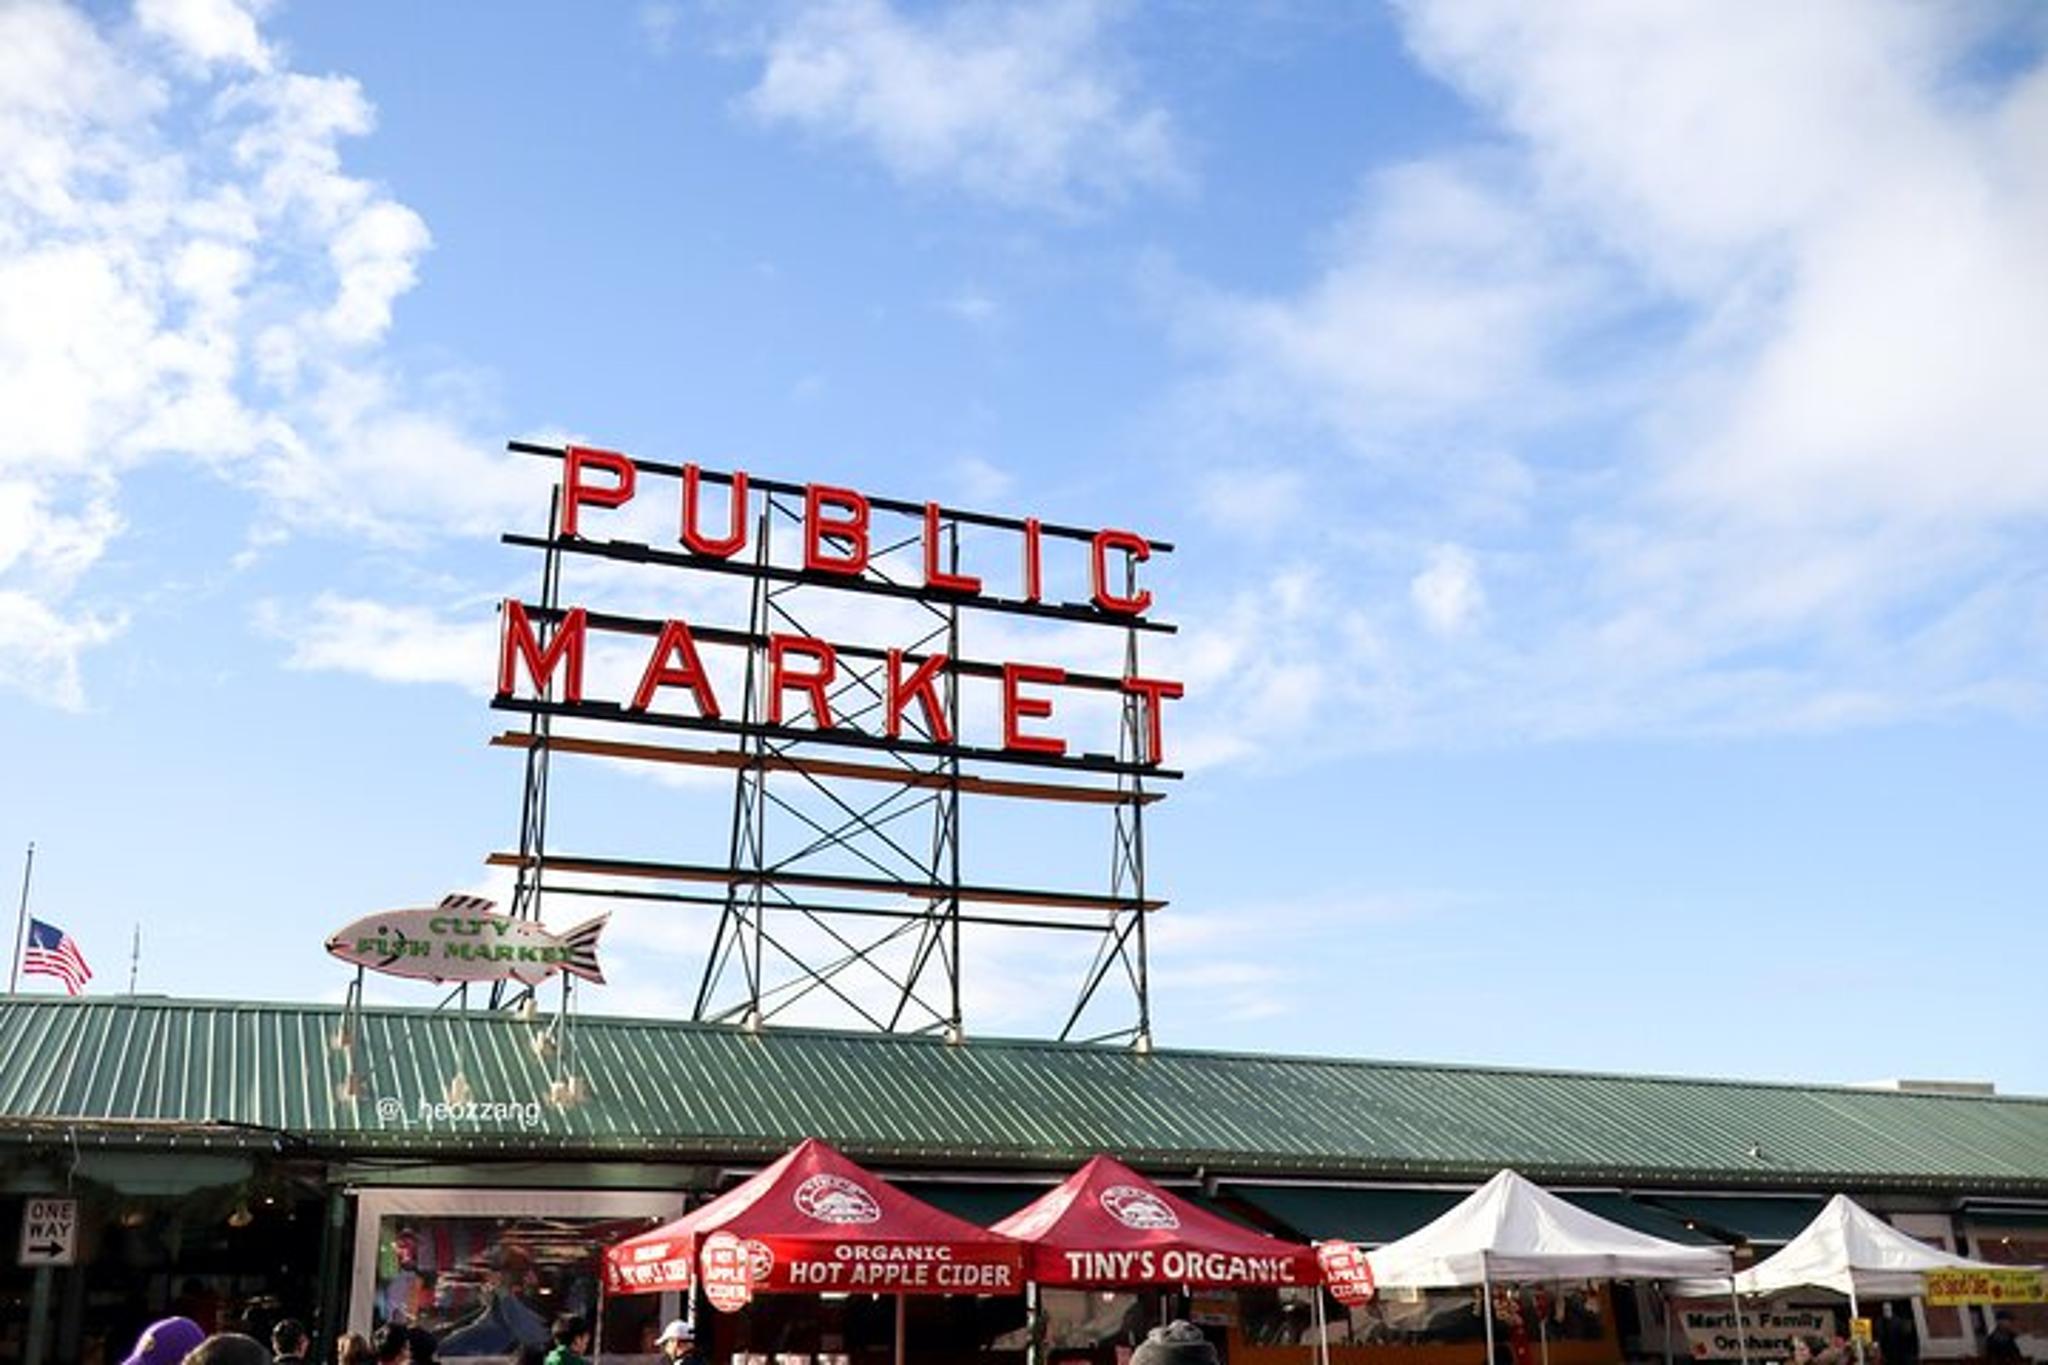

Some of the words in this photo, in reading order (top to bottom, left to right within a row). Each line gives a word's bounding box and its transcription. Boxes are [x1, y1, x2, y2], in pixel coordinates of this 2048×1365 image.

[562, 445, 1153, 616] PUBLIC
[499, 600, 1184, 766] MARKET
[429, 917, 510, 935] CITY
[357, 937, 430, 958] FISH
[444, 941, 574, 963] MARKET
[31, 1202, 73, 1220] ONE
[30, 1222, 72, 1238] WAY
[835, 1245, 952, 1261] ORGANIC
[790, 1262, 843, 1284] HOT
[851, 1263, 928, 1285] APPLE
[937, 1264, 1011, 1286] CIDER
[1065, 1251, 1155, 1280] TINY'S
[1162, 1251, 1295, 1282] ORGANIC
[1760, 1313, 1823, 1329] Family
